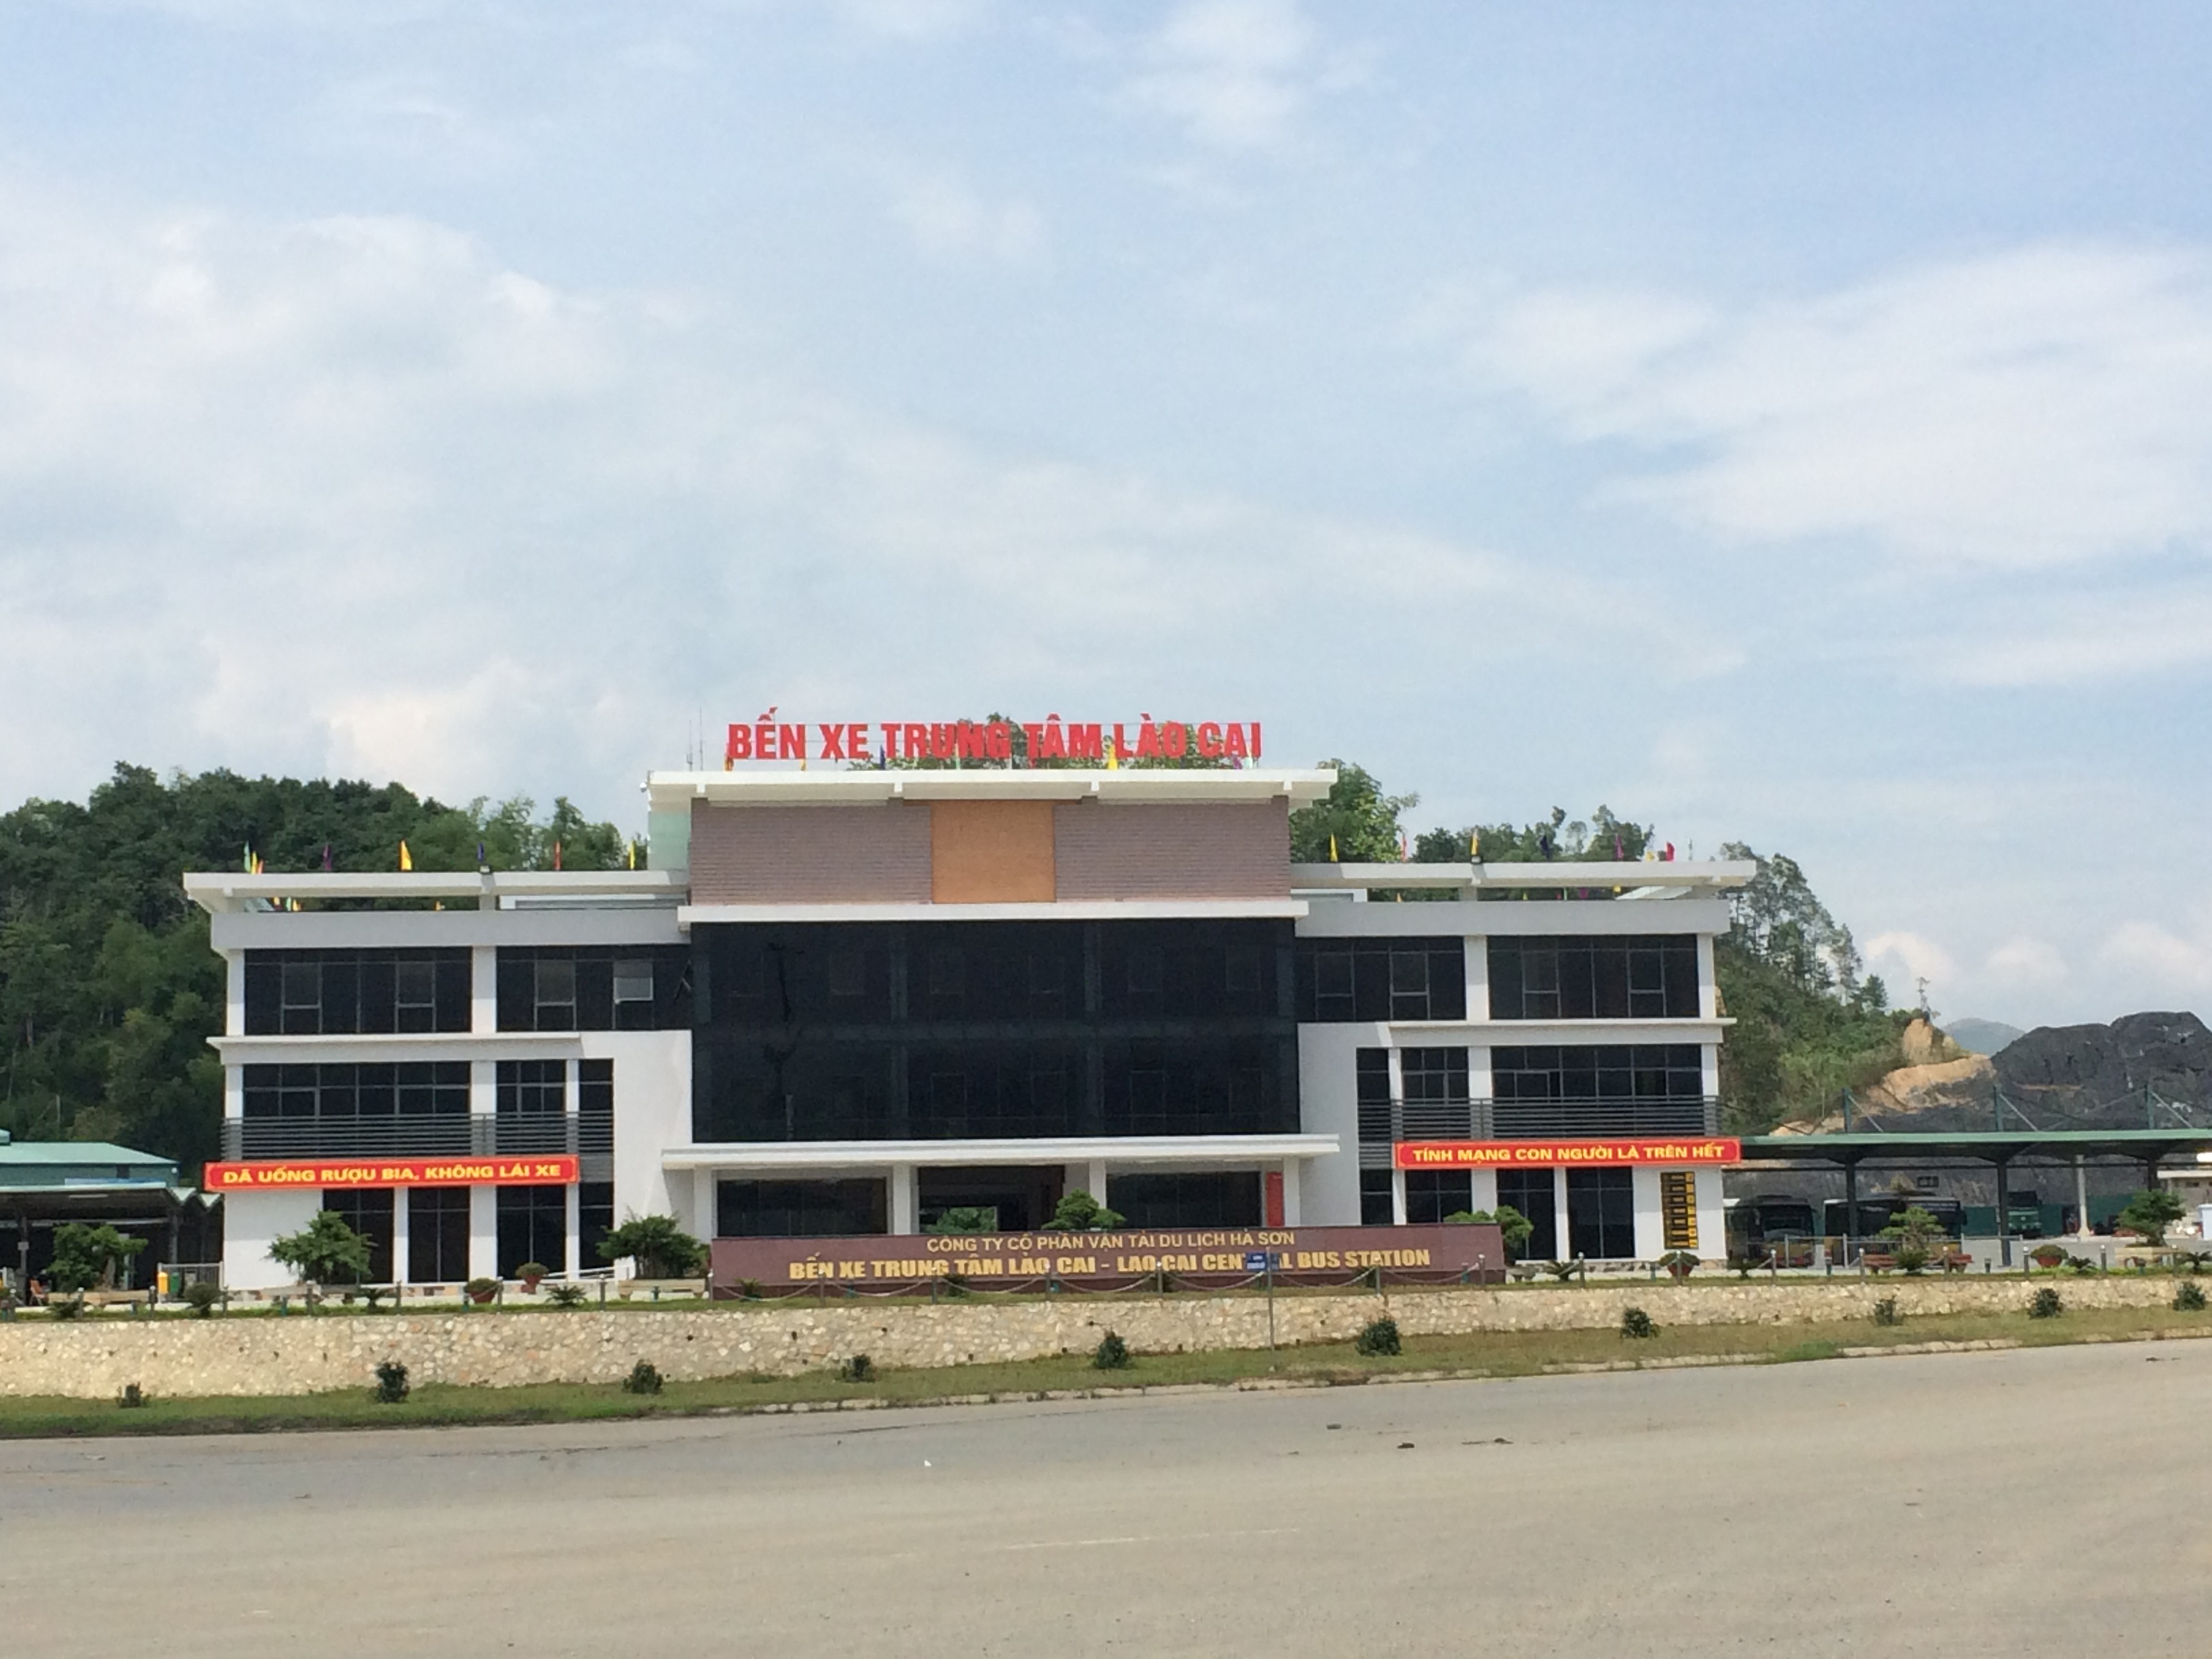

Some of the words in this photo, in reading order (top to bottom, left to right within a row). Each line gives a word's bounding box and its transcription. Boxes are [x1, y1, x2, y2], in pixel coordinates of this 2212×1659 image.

[729, 706, 806, 759] BẾN
[819, 722, 869, 759] XE
[881, 722, 1010, 759] TRUNG
[1023, 713, 1103, 758] TÂM
[1113, 713, 1187, 758] LÀO
[1197, 722, 1261, 758] CAI
[1413, 1147, 1452, 1162] TÍNH
[1458, 1149, 1511, 1164] MẠNG
[1515, 1149, 1552, 1160] CON
[1557, 1145, 1612, 1160] NGƯỜI
[1618, 1145, 1639, 1158] LÀ
[1643, 1145, 1687, 1158] TRÊN
[1692, 1142, 1725, 1158] HẾT
[258, 1166, 316, 1182] UỐNG
[321, 1168, 376, 1184] RƯỢU
[425, 1164, 494, 1179] KHÔNG
[499, 1163, 530, 1177] LÁI
[535, 1164, 561, 1176] XE
[927, 1235, 977, 1252] CÔNG
[981, 1237, 1004, 1251] TY
[1160, 1234, 1183, 1247] DU
[1187, 1233, 1226, 1251] LỊCH
[1258, 1232, 1295, 1245] SƠN
[790, 1252, 834, 1279] BẾN
[839, 1261, 866, 1277] XE
[870, 1260, 949, 1277] TRUNG
[954, 1253, 1003, 1275] TÂM
[1008, 1252, 1050, 1275] LÀO
[1057, 1256, 1096, 1273] CAI
[1118, 1255, 1156, 1272] LAO
[1160, 1254, 1197, 1271] CAI
[1297, 1251, 1340, 1268] BUS
[1345, 1249, 1431, 1267] STATION
